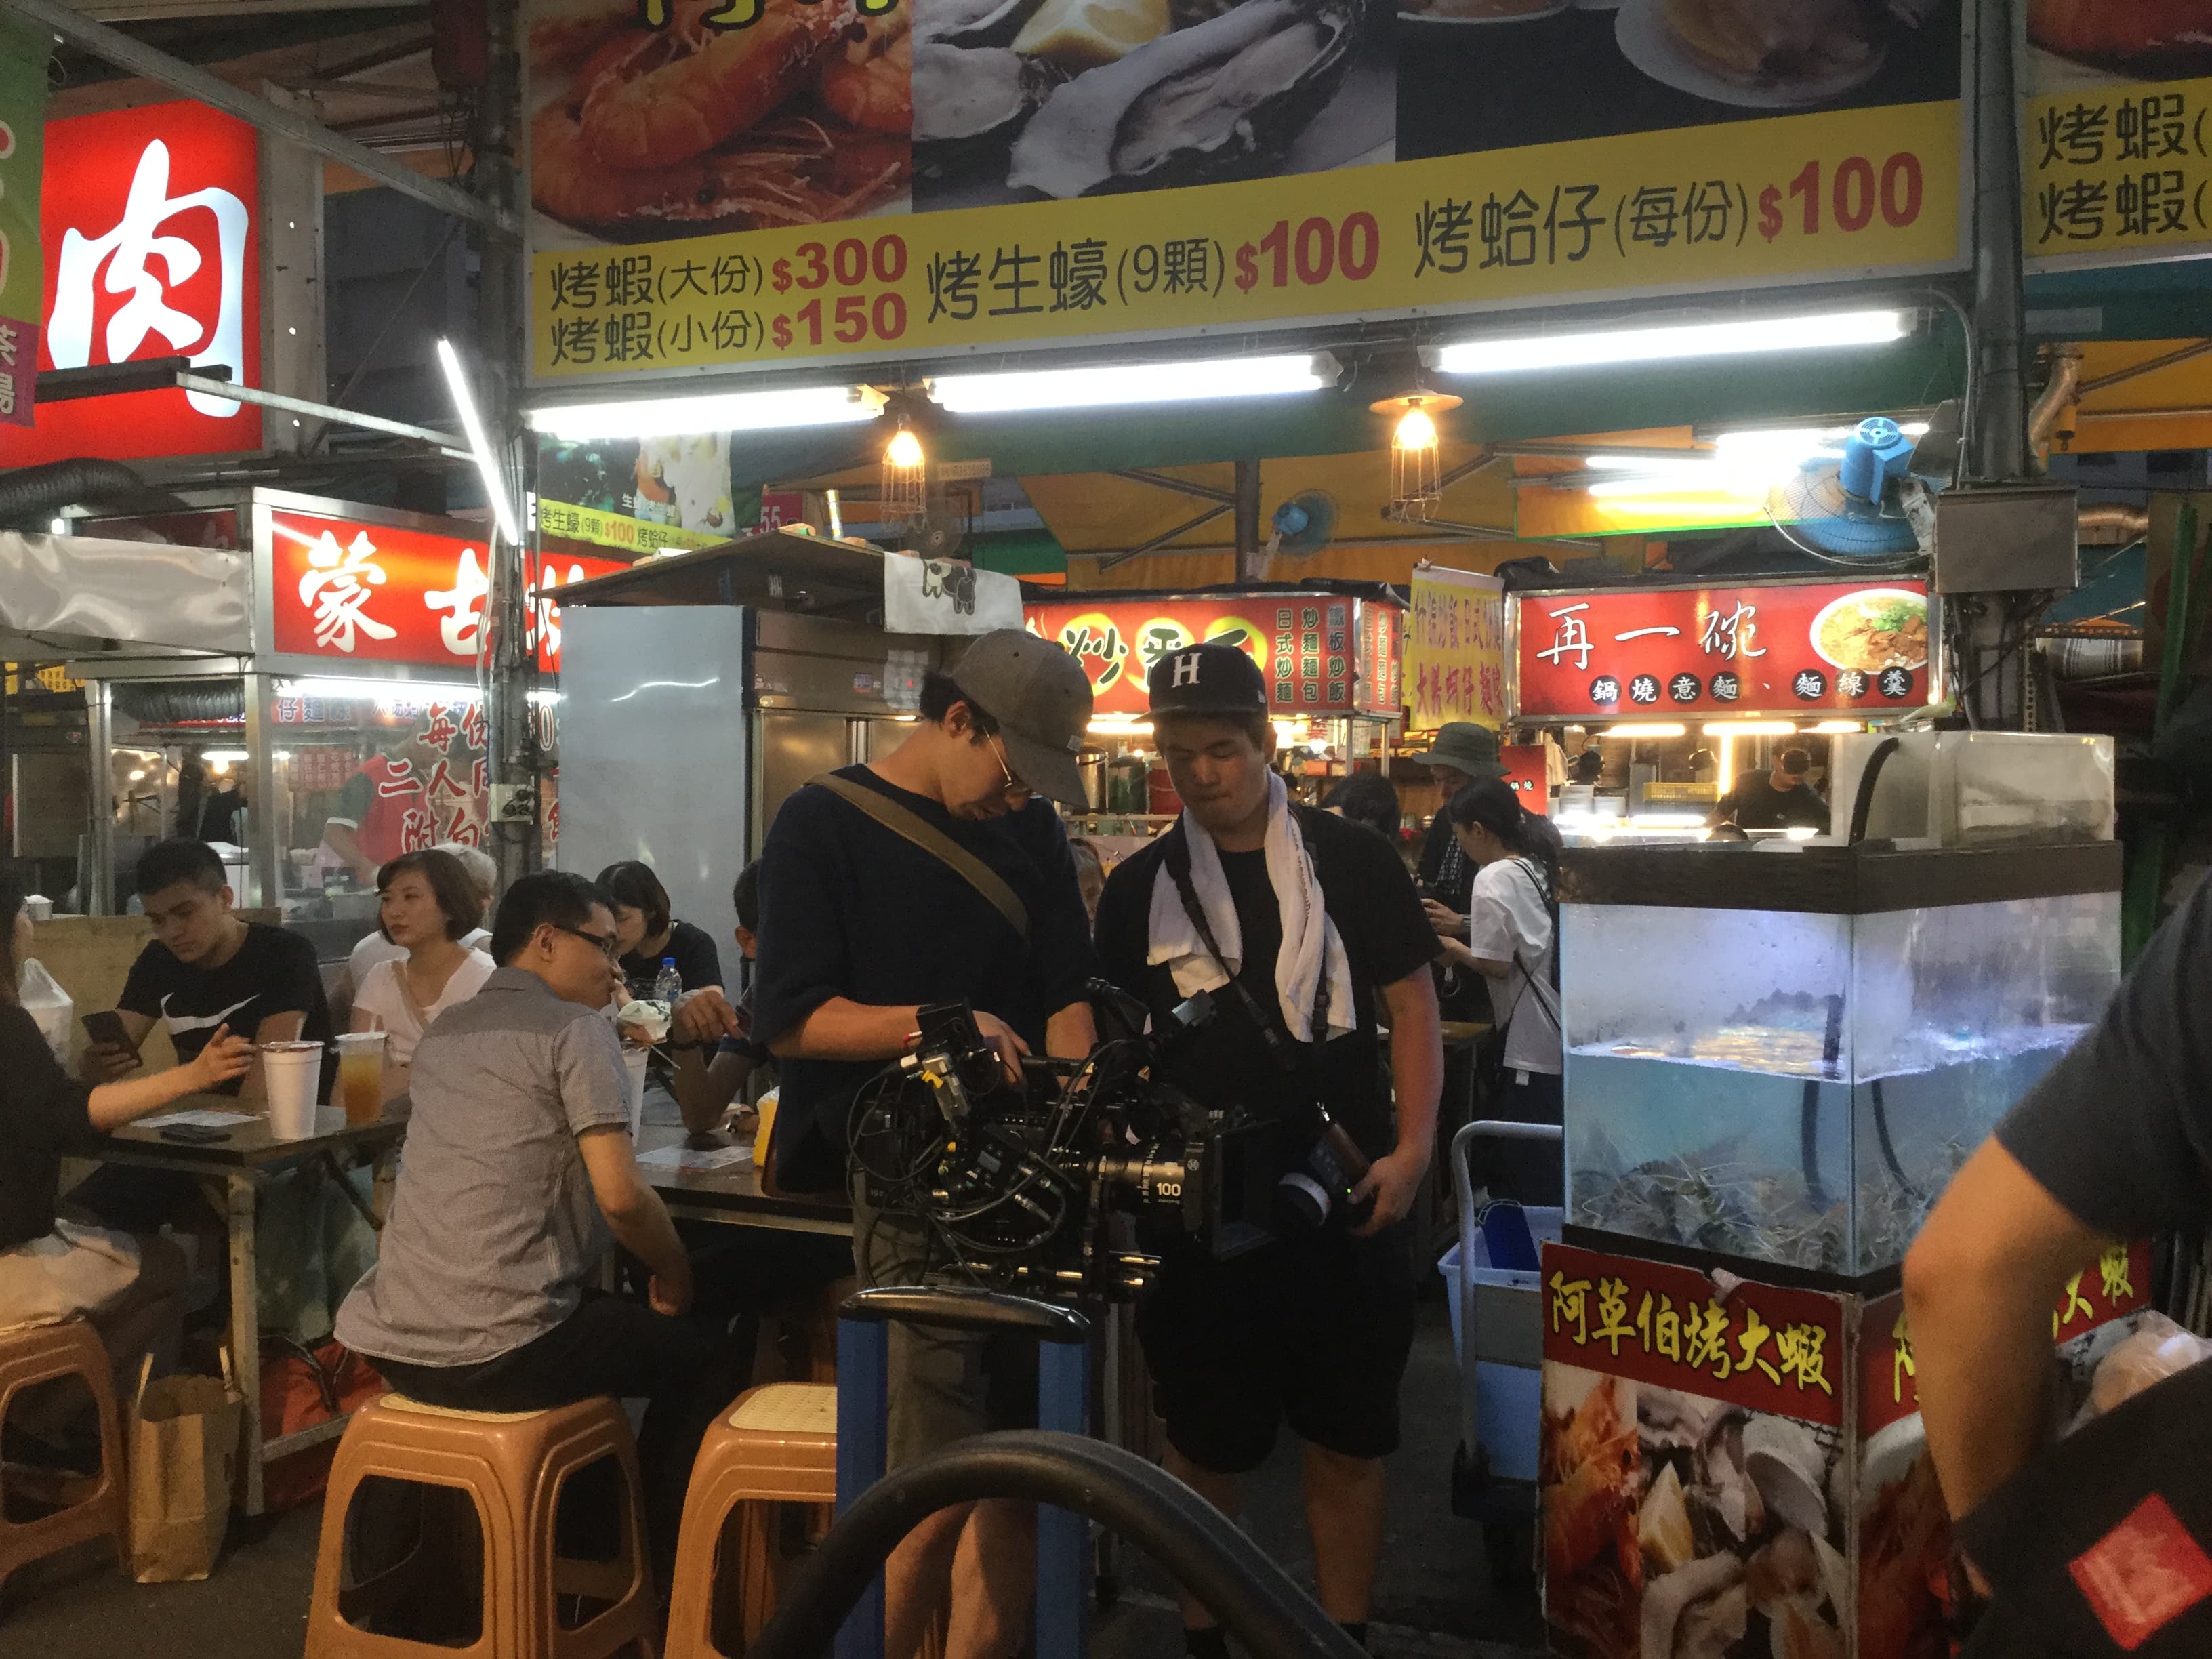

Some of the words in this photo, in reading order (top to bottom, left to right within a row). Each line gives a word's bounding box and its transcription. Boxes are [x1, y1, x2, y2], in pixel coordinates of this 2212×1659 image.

[1414, 180, 1748, 278] 烤蛤仔(每份)
[1758, 152, 1923, 243] $100
[47, 138, 249, 417] 肉
[551, 255, 764, 311] 烤蝦(大份)
[772, 234, 907, 294] $300
[927, 237, 1225, 323] 烤生蠔(9顆)
[1235, 211, 1380, 294] $100
[551, 310, 764, 366] 烤蝦(小份)
[772, 293, 907, 350] $150
[1171, 652, 1203, 688] H
[1275, 607, 1294, 703] 日式炒麵
[1300, 607, 1319, 702] 炒麵麵包
[1537, 600, 1767, 670] 再一碗
[1156, 1182, 1181, 1197] 100
[1549, 1269, 1835, 1397] 阿草伯烤大蝦
